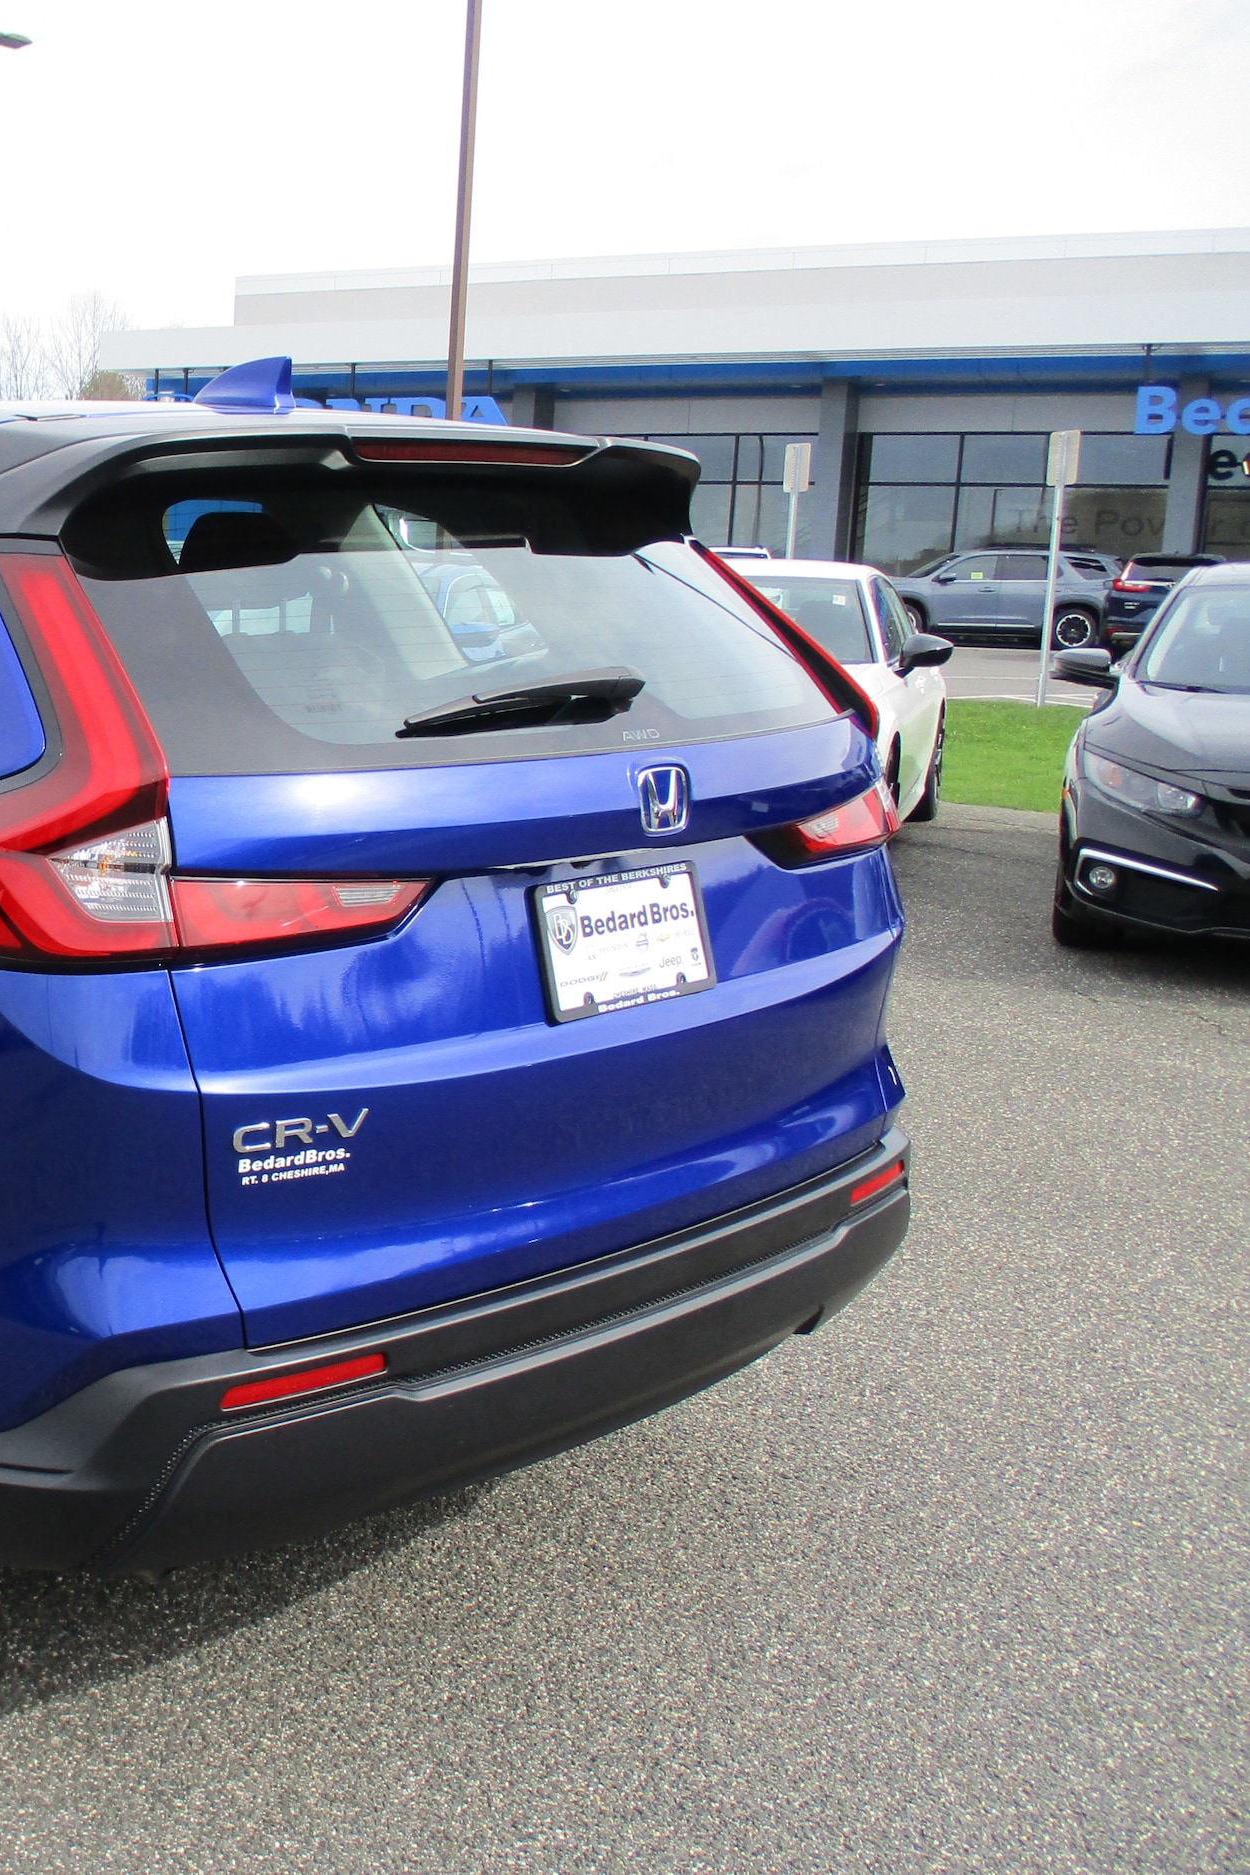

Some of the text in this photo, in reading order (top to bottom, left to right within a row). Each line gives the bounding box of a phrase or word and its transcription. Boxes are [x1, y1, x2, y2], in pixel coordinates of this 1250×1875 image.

[622, 728, 660, 741] AWD
[546, 881, 576, 894] BEST
[579, 878, 594, 888] OF
[596, 873, 619, 885] THE
[621, 863, 687, 881] BERKSHIRES
[579, 910, 648, 938] Bedard
[649, 902, 694, 925] Bros.
[659, 955, 682, 969] Jeep
[598, 989, 680, 1013] Bedard Bros.
[233, 1108, 369, 1153] CR-V
[238, 1147, 351, 1174] BedardBros.
[241, 1175, 258, 1186] RT.
[261, 1173, 269, 1184] 8
